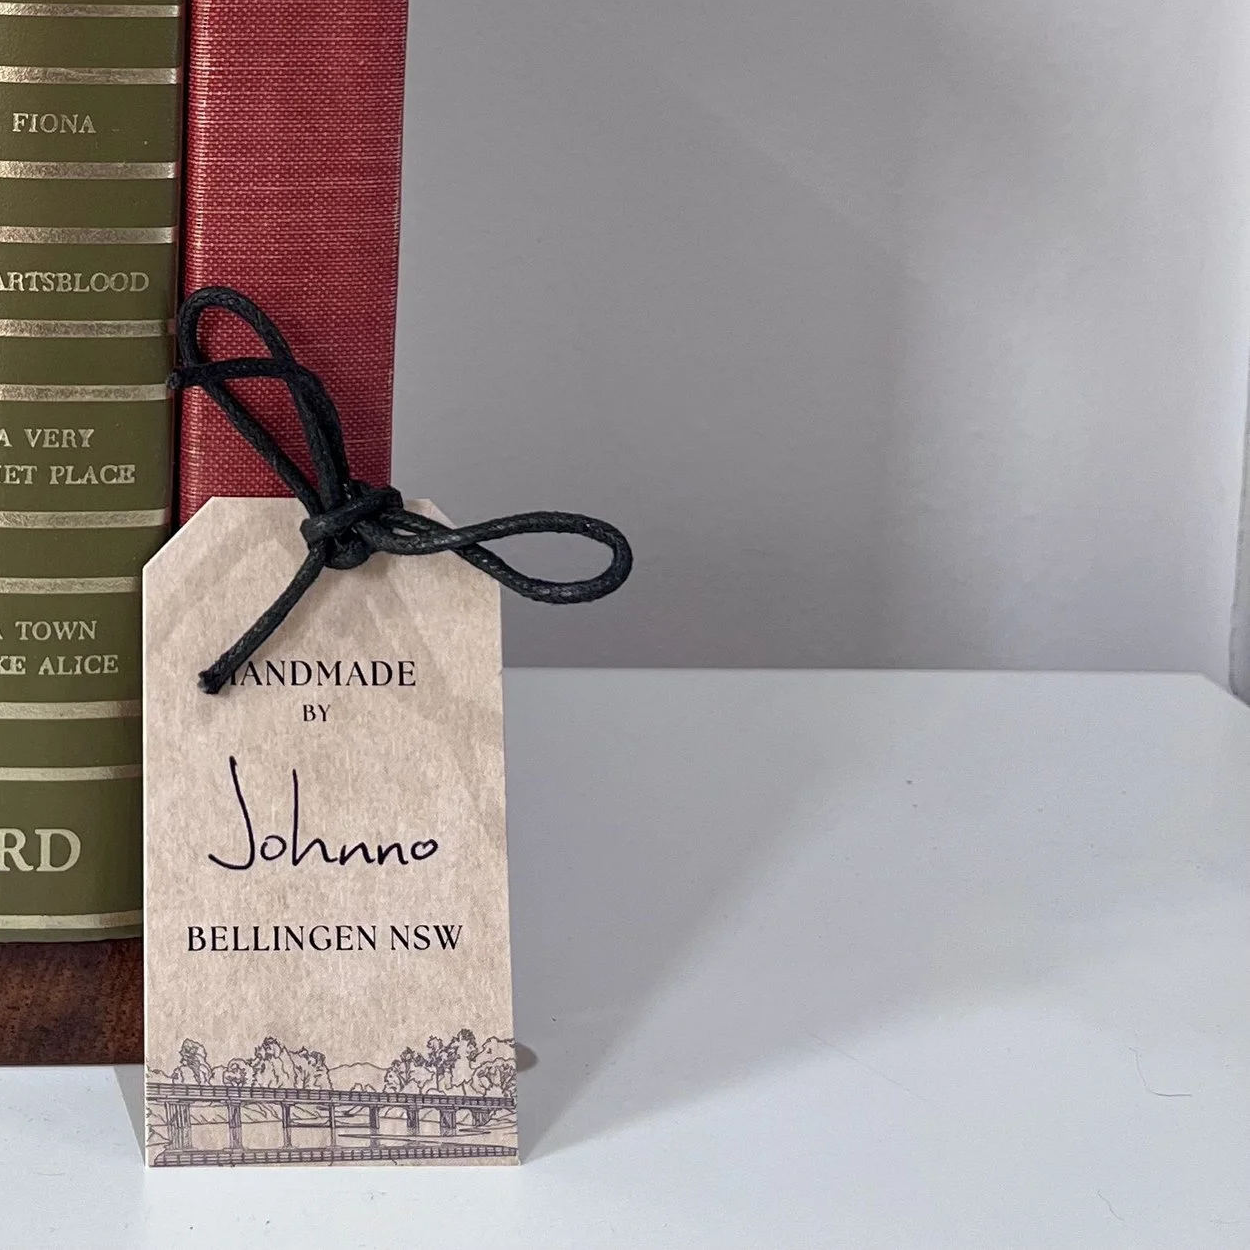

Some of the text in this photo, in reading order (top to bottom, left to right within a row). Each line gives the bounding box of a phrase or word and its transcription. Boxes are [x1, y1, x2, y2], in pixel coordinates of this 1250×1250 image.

[12, 112, 97, 135] FIONA
[24, 428, 95, 449] VERY
[49, 464, 136, 485] PLACE
[15, 620, 98, 641] TOWN
[38, 655, 119, 674] ALICE
[302, 704, 331, 722] BY
[208, 755, 439, 871] Johnno
[187, 924, 463, 952] BELLINGEN NSW
